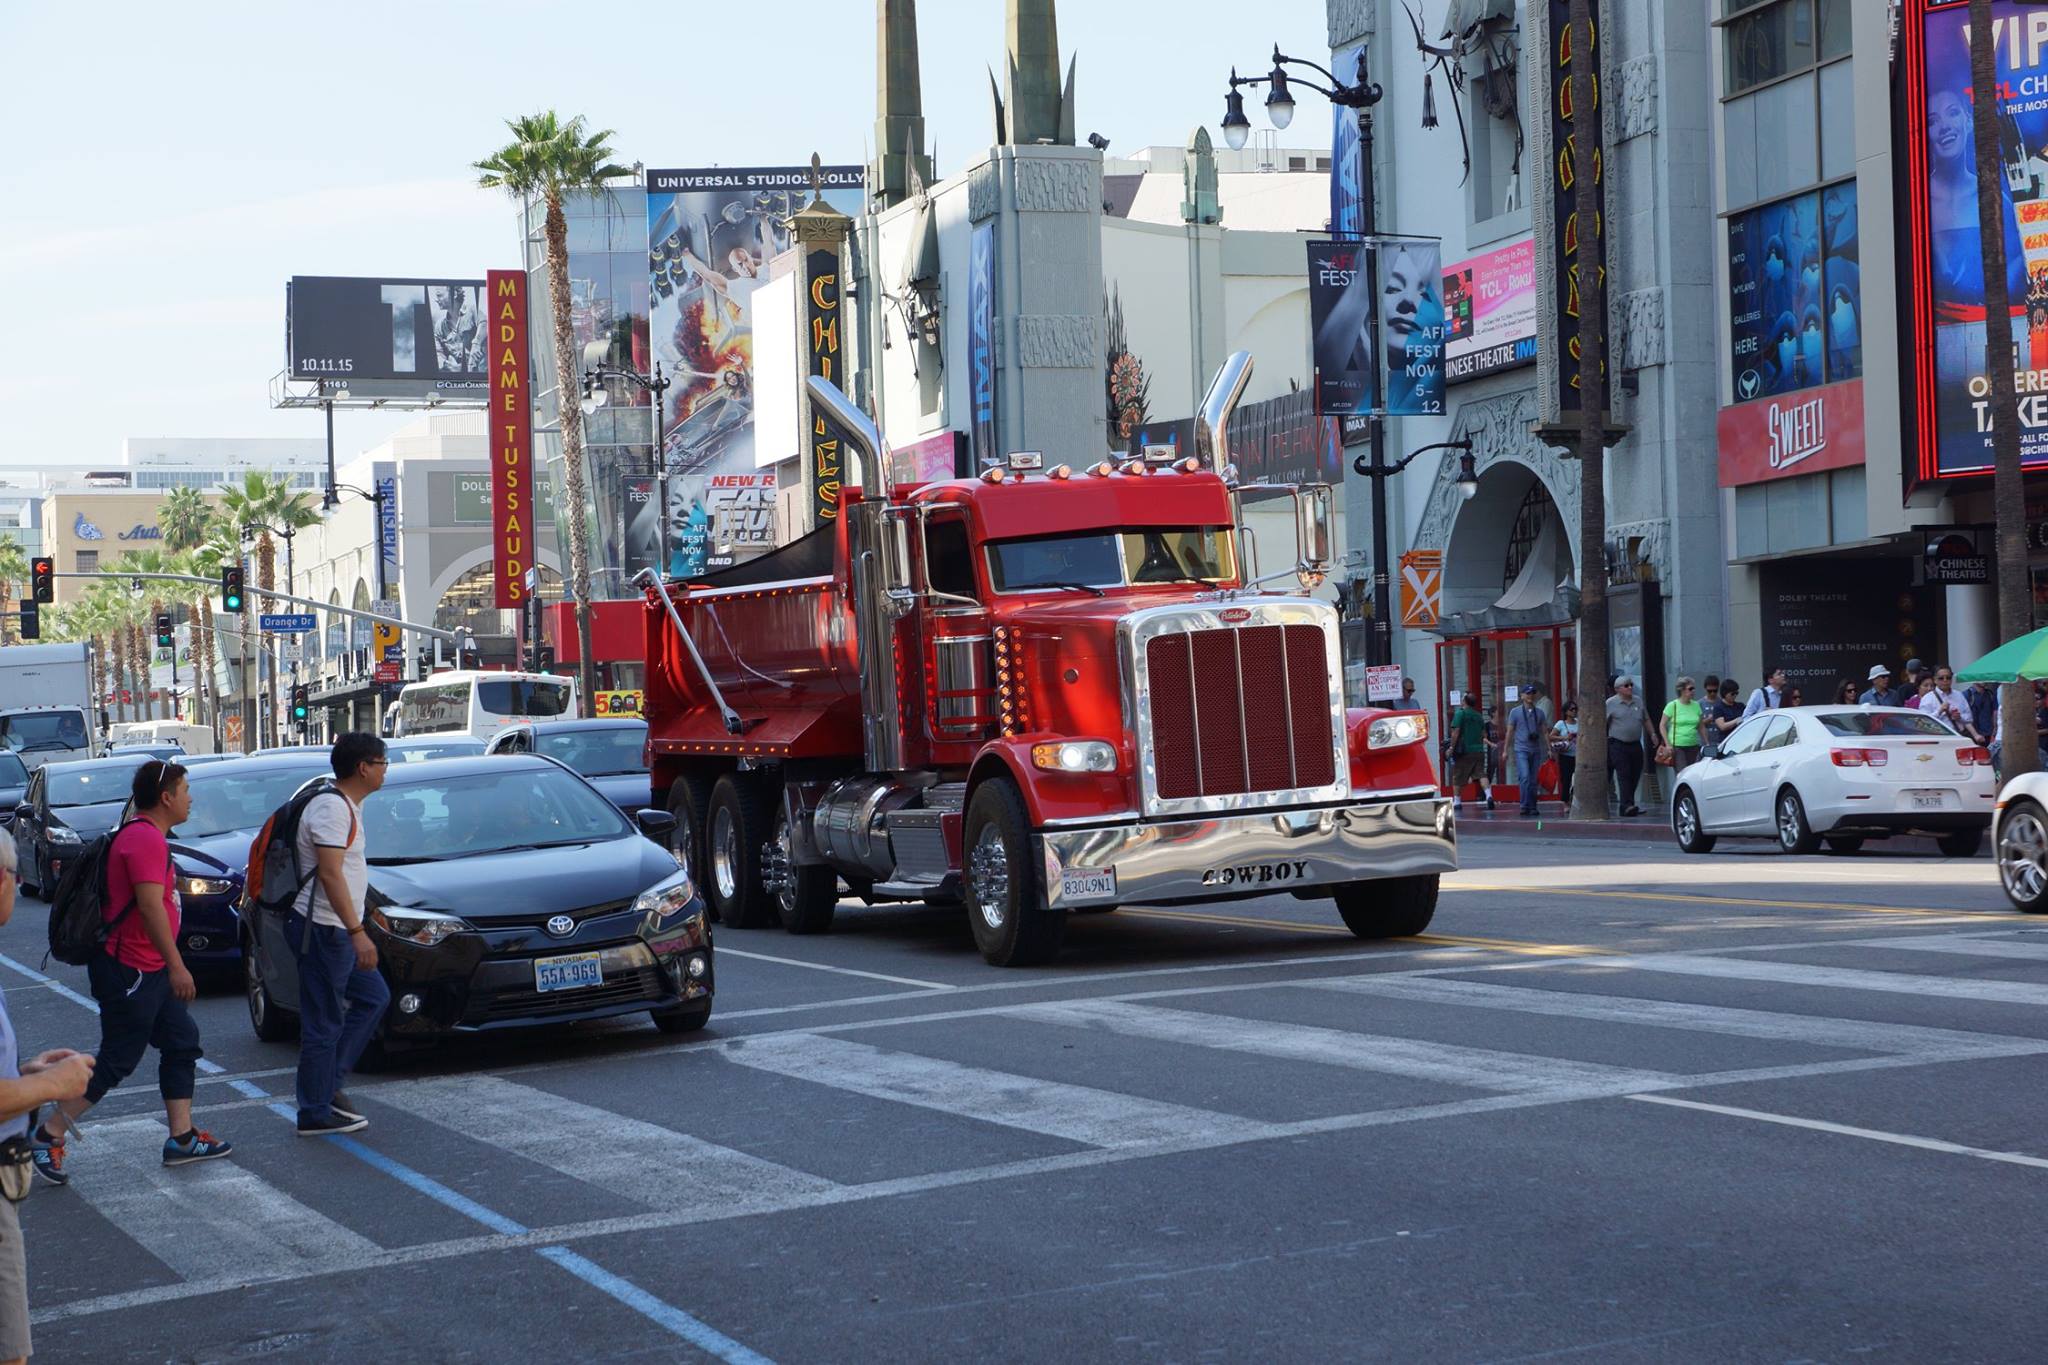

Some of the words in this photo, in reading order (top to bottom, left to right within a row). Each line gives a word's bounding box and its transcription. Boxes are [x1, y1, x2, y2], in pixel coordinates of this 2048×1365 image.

[1964, 81, 2018, 104] TL
[2006, 104, 2023, 115] THE
[657, 175, 743, 188] UNIVERSAL
[747, 173, 811, 186] STUDIOS
[1732, 253, 1746, 265] INTO
[1320, 270, 1357, 286] FEST
[1480, 279, 1503, 300] TCL
[1733, 281, 1755, 294] WYLAND
[1734, 311, 1761, 325] GALLERIES
[1422, 326, 1445, 339] AFI
[498, 279, 519, 411] MADAME
[1406, 345, 1441, 358] FEST
[1735, 336, 1758, 355] HERE
[1474, 343, 1515, 371] THEATRE
[302, 358, 353, 372] 10.11.15
[1406, 364, 1436, 378] NOV
[1422, 400, 1440, 413] 12
[1346, 419, 1366, 432] IMAX
[2019, 434, 2037, 445] ALL
[712, 475, 755, 486] NEW
[630, 492, 653, 502] FEST
[504, 425, 521, 600] TUSSAUDS
[682, 535, 705, 543] FEST
[682, 547, 702, 555] NOV
[707, 557, 732, 566] AND
[1940, 559, 1986, 569] CHINESE
[692, 568, 705, 576] 12
[1940, 570, 1986, 579] THEATRES
[265, 618, 297, 630] Orange
[301, 617, 312, 626] Dr
[1781, 644, 1796, 652] TCL
[1799, 643, 1835, 651] CHINESE
[1846, 643, 1888, 651] THEATRES
[1202, 861, 1309, 887] COWBOY
